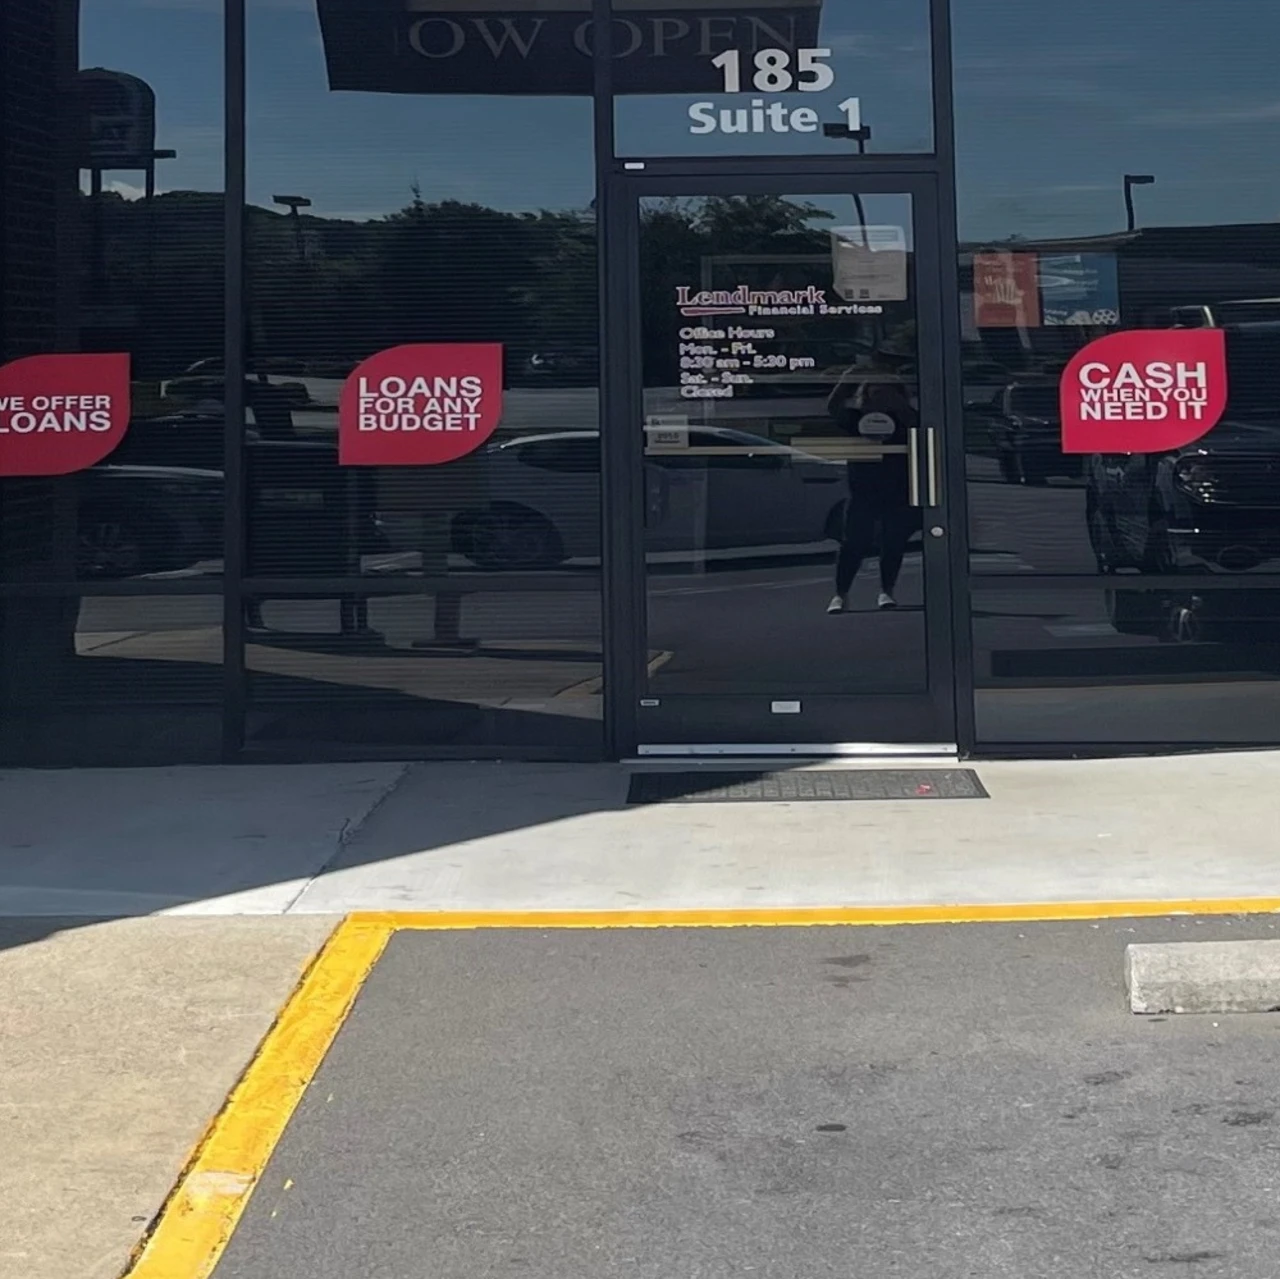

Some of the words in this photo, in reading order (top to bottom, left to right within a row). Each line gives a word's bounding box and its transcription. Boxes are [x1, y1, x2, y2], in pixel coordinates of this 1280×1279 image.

[711, 47, 834, 93] 185
[688, 99, 819, 135] Suite
[837, 96, 862, 132] 1
[675, 285, 827, 306] Lendmark
[747, 304, 815, 316] Financial
[818, 303, 883, 315] Services
[678, 326, 726, 340] Office
[727, 326, 775, 339] Hours
[789, 356, 815, 370] pm
[1078, 361, 1208, 389] CASH
[358, 376, 483, 398] LOANS
[680, 384, 734, 398] Closed
[1080, 388, 1154, 402] WHEN
[1156, 387, 1208, 402] YOU
[31, 395, 112, 410] OFFER
[359, 398, 418, 412] FOR
[423, 397, 481, 412] ANY
[1079, 401, 1168, 421] NEED
[1177, 400, 1208, 420] IT
[359, 412, 482, 432] BUDGET
